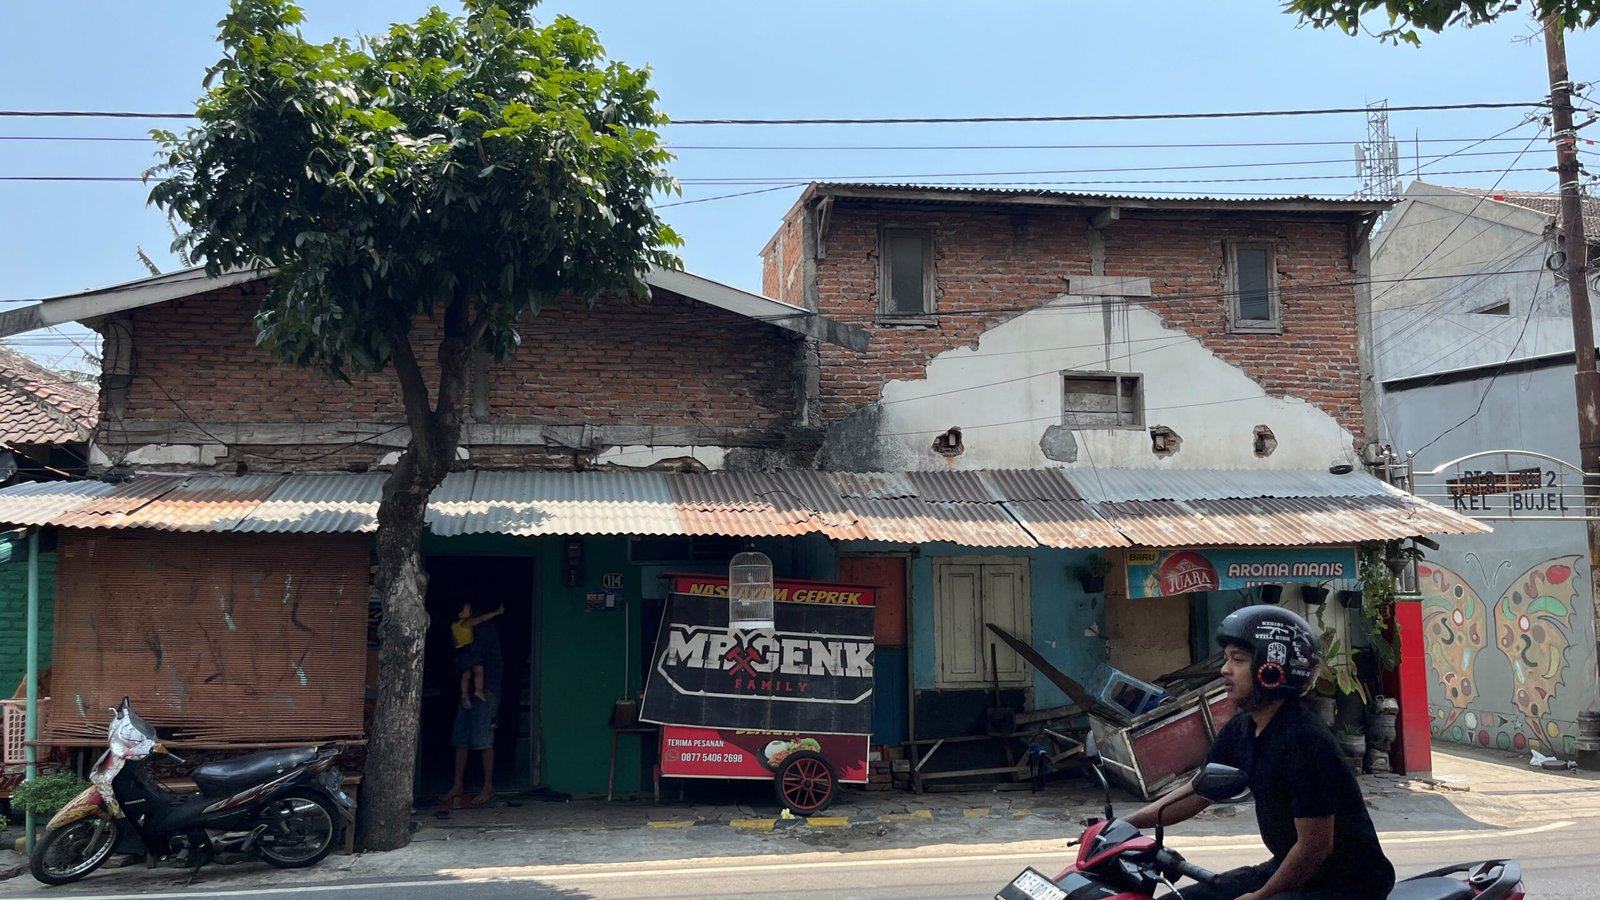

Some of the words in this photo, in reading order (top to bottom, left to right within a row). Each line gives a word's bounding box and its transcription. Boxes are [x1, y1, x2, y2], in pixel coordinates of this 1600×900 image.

[1545, 471, 1557, 487] 2
[1452, 493, 1491, 510] KEL
[1513, 493, 1568, 510] BUJEL
[1129, 553, 1155, 562] BARU
[1228, 563, 1289, 578] AROMA
[1293, 562, 1343, 577] MANIS
[607, 575, 621, 587] 114
[1169, 571, 1211, 592] JUARA
[792, 589, 863, 605] GEPREK
[751, 636, 875, 677] GENK
[734, 679, 808, 692] FAMILY
[668, 739, 692, 747] TERIMA
[693, 740, 726, 748] PESANAN:
[681, 753, 700, 762] 0877
[702, 753, 722, 762] 5406
[723, 753, 743, 763] 2698
